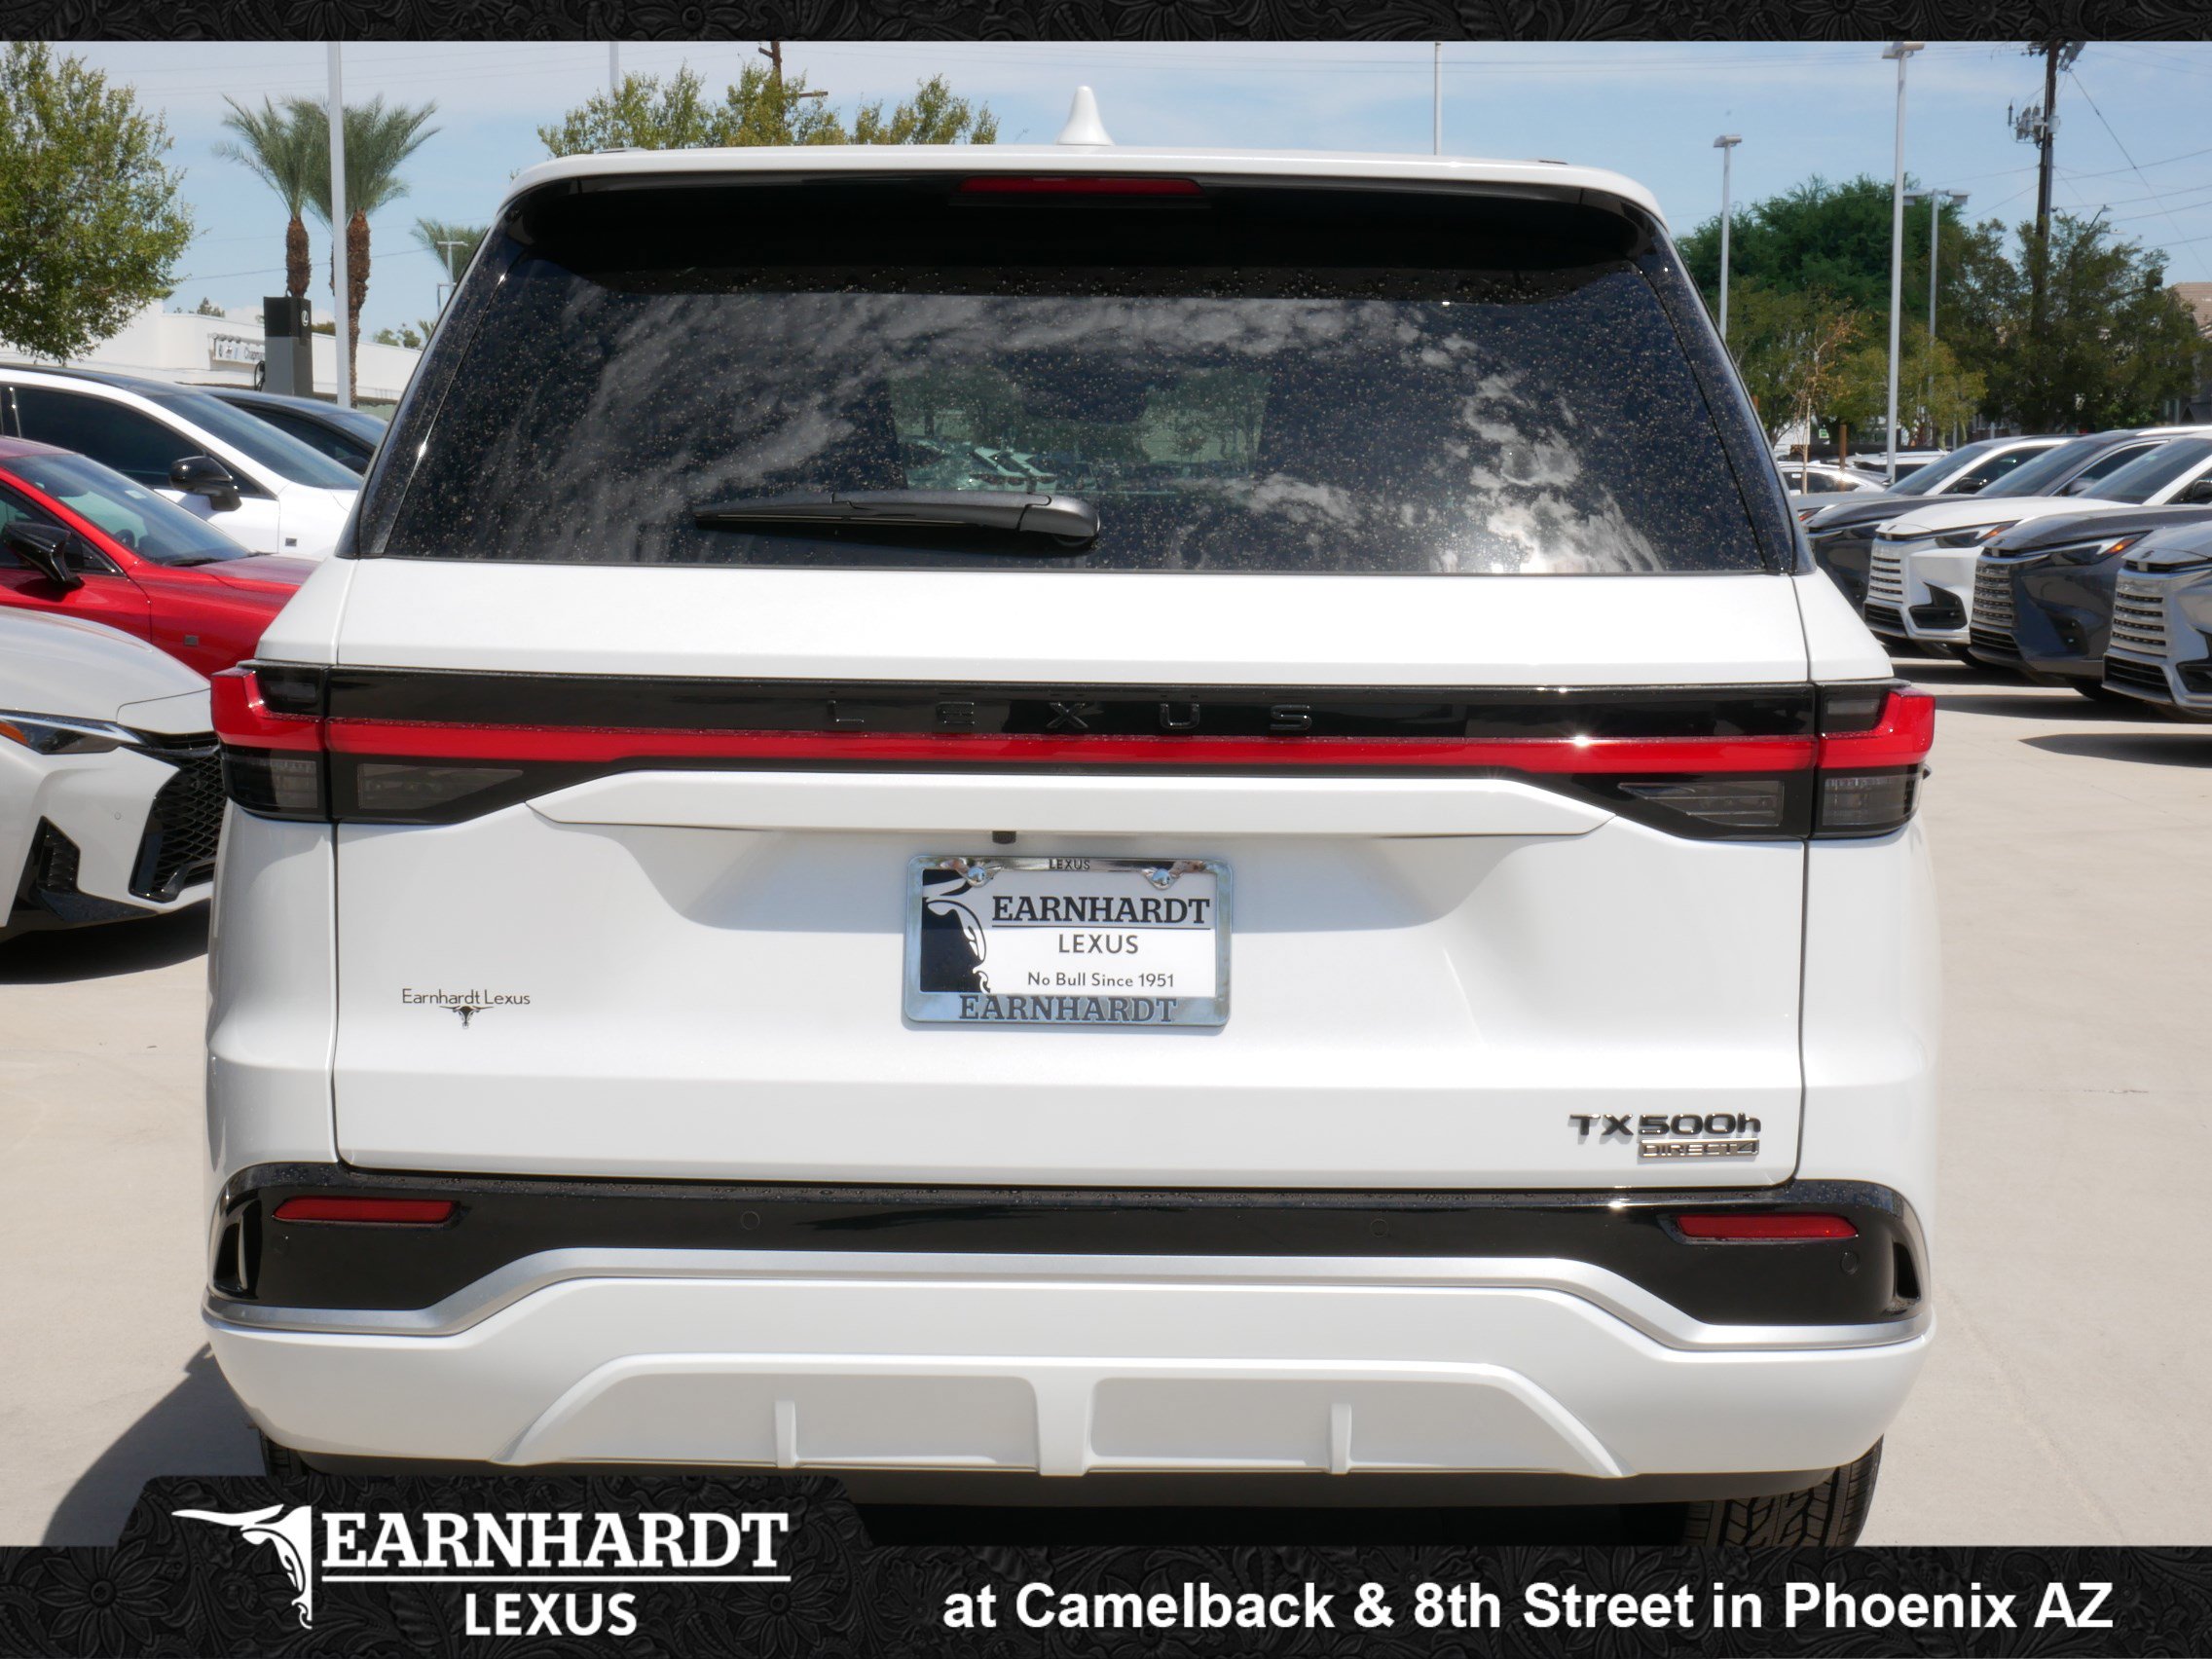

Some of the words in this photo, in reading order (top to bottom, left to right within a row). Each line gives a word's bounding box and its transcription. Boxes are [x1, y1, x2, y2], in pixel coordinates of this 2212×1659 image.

[826, 699, 1311, 731] LEXUS
[1049, 859, 1090, 870] LEXUS
[992, 896, 1210, 924] EARNHARDT
[1058, 934, 1138, 954] LEXUS
[1027, 972, 1051, 986] No
[1055, 972, 1087, 986] Bull
[1091, 973, 1133, 987] Since
[1138, 974, 1174, 987] 1951
[402, 987, 480, 1005] Earnhardt
[484, 989, 531, 1005] Lexus
[959, 995, 1176, 1022] EARNHARDT
